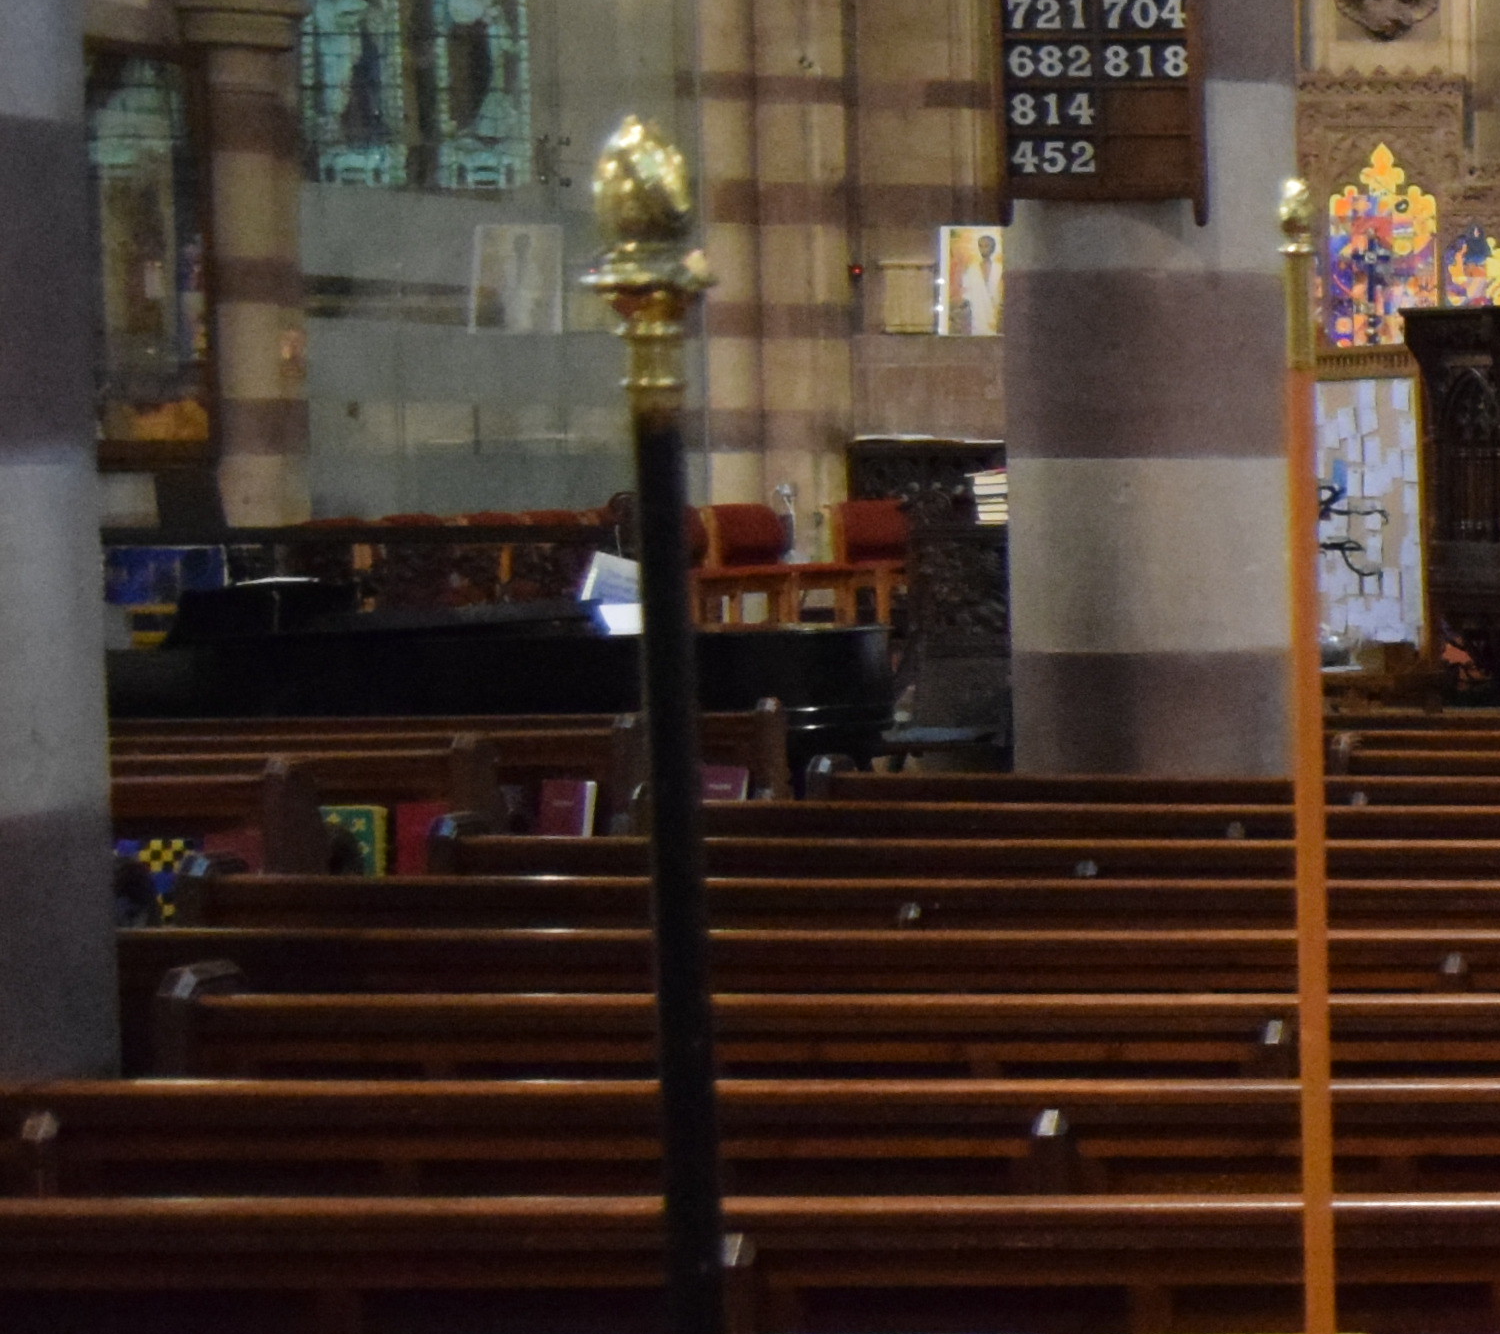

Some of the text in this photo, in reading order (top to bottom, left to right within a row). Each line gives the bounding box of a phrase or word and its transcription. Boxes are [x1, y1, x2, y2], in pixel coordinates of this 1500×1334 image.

[1007, 44, 1189, 78] 682 818
[1010, 92, 1096, 126] 814
[1013, 141, 1096, 173] 452
